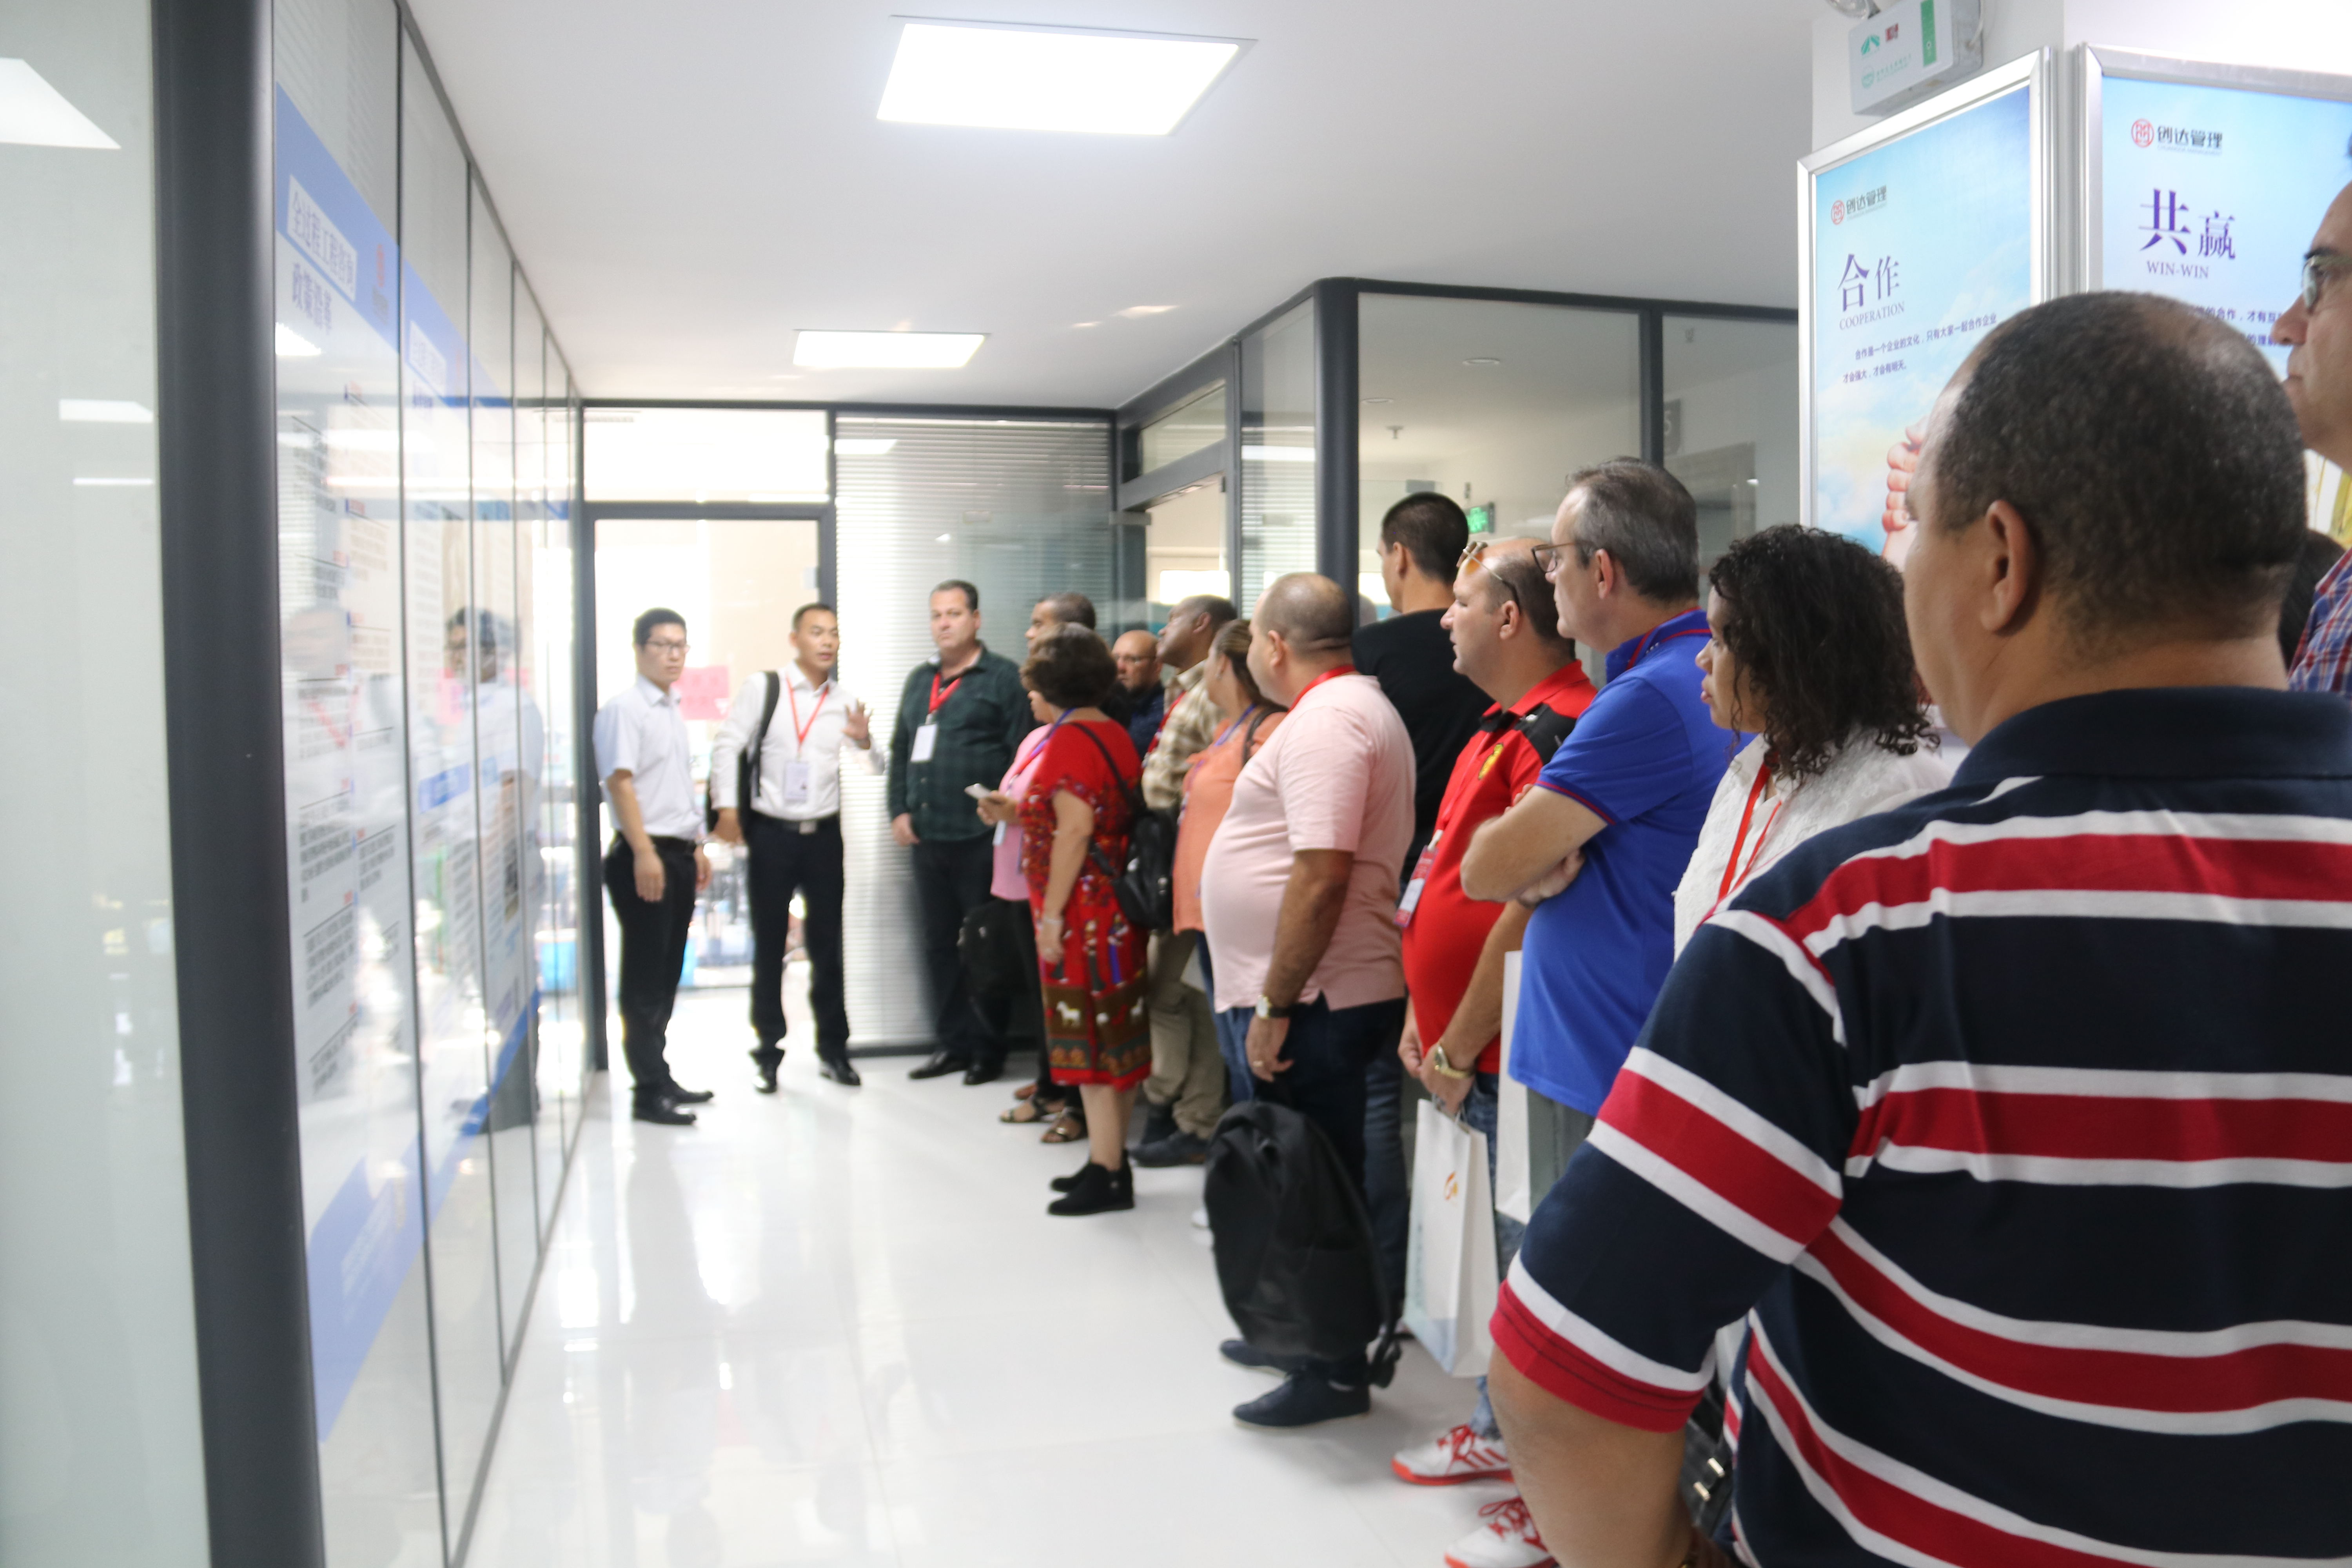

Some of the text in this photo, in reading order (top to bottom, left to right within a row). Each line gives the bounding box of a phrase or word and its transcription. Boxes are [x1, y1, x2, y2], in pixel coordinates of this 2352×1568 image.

[2158, 125, 2223, 148] 创达管理
[1846, 185, 1887, 214] 创达管理
[2138, 188, 2236, 260] 共赢
[1837, 254, 1900, 312] 合作
[2147, 260, 2209, 279] WIN-WIN
[1839, 301, 1905, 330] COOPERATION
